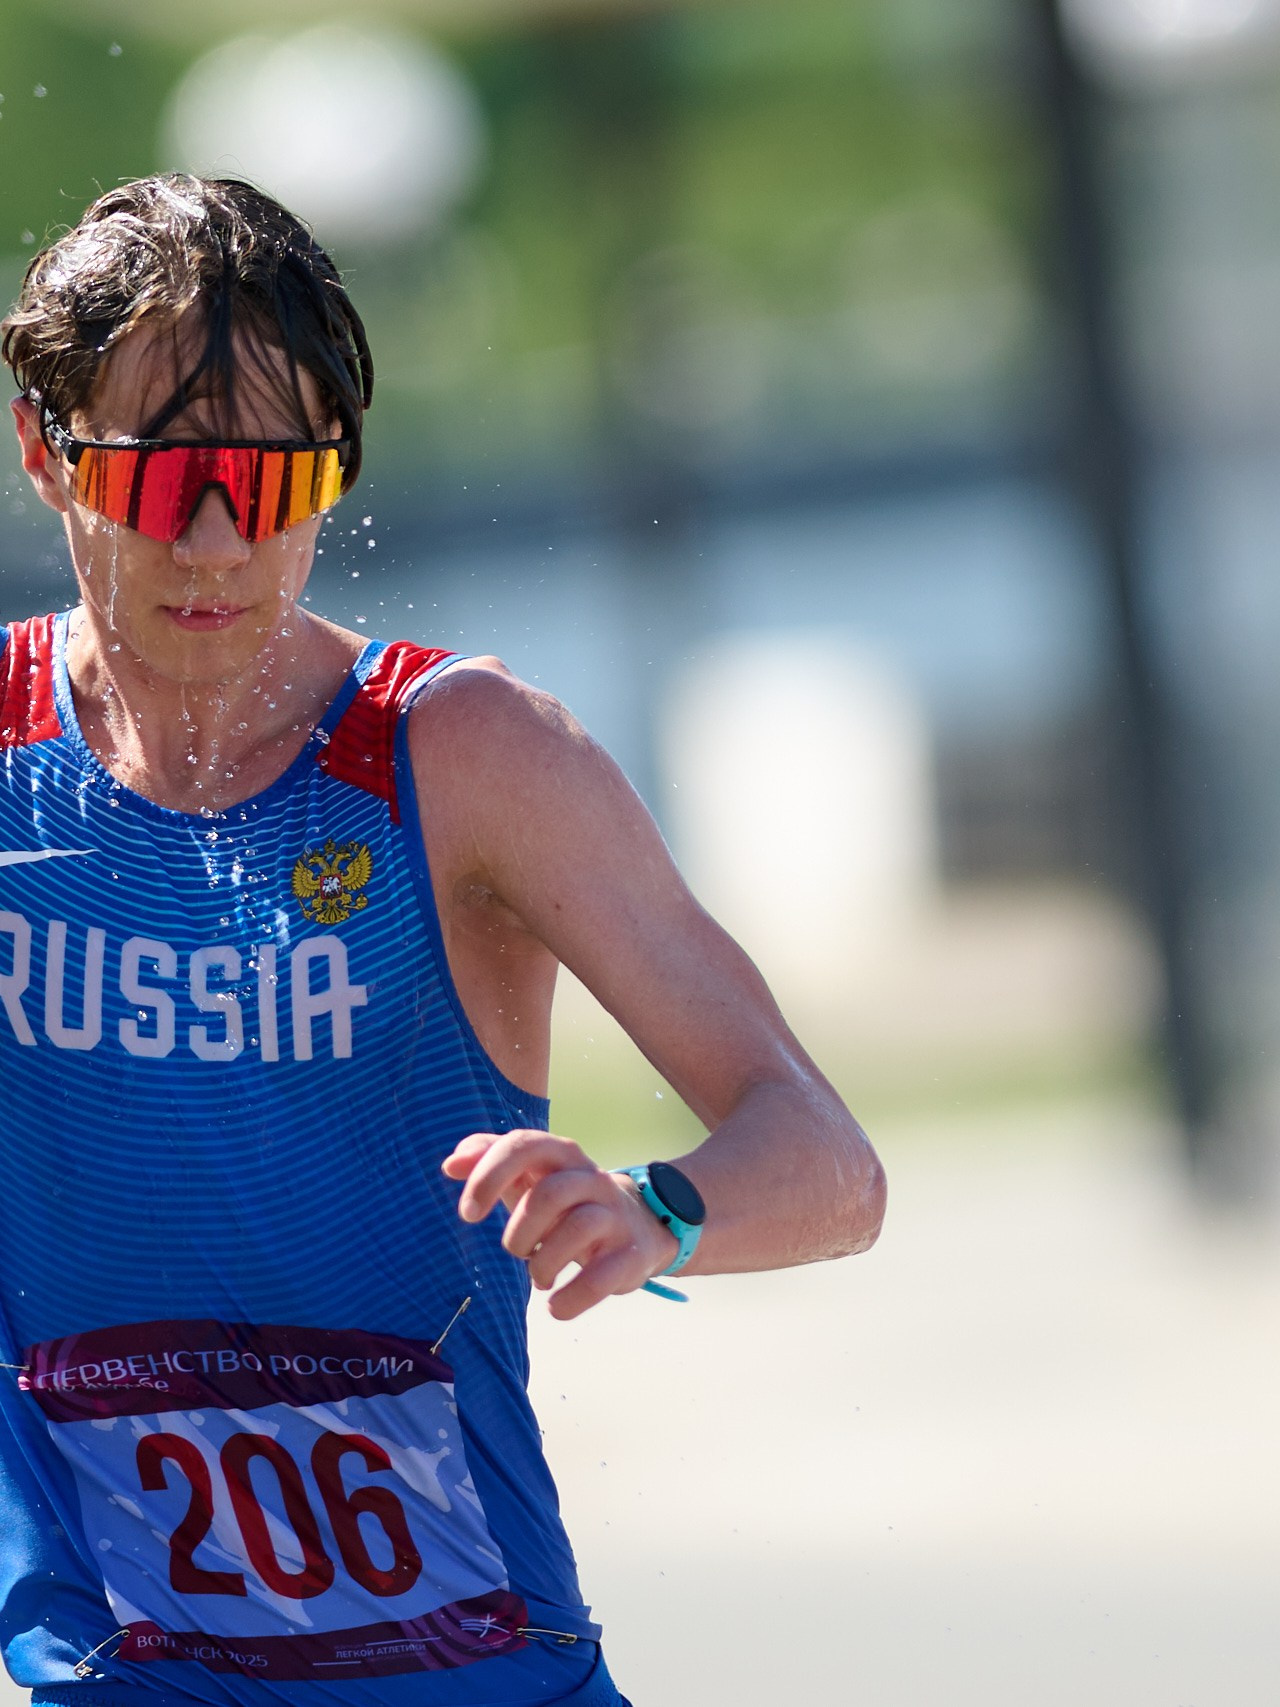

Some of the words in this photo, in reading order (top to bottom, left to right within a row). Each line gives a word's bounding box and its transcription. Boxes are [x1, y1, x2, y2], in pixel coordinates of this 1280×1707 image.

[35, 1349, 263, 1390] ПЕРВЕНСТВО
[269, 1354, 414, 1379] РОССИИ
[136, 1433, 422, 1599] 206
[336, 1648, 375, 1659] ЛЕГКОЙ
[377, 1643, 426, 1654] АТЛЕТИКИ
